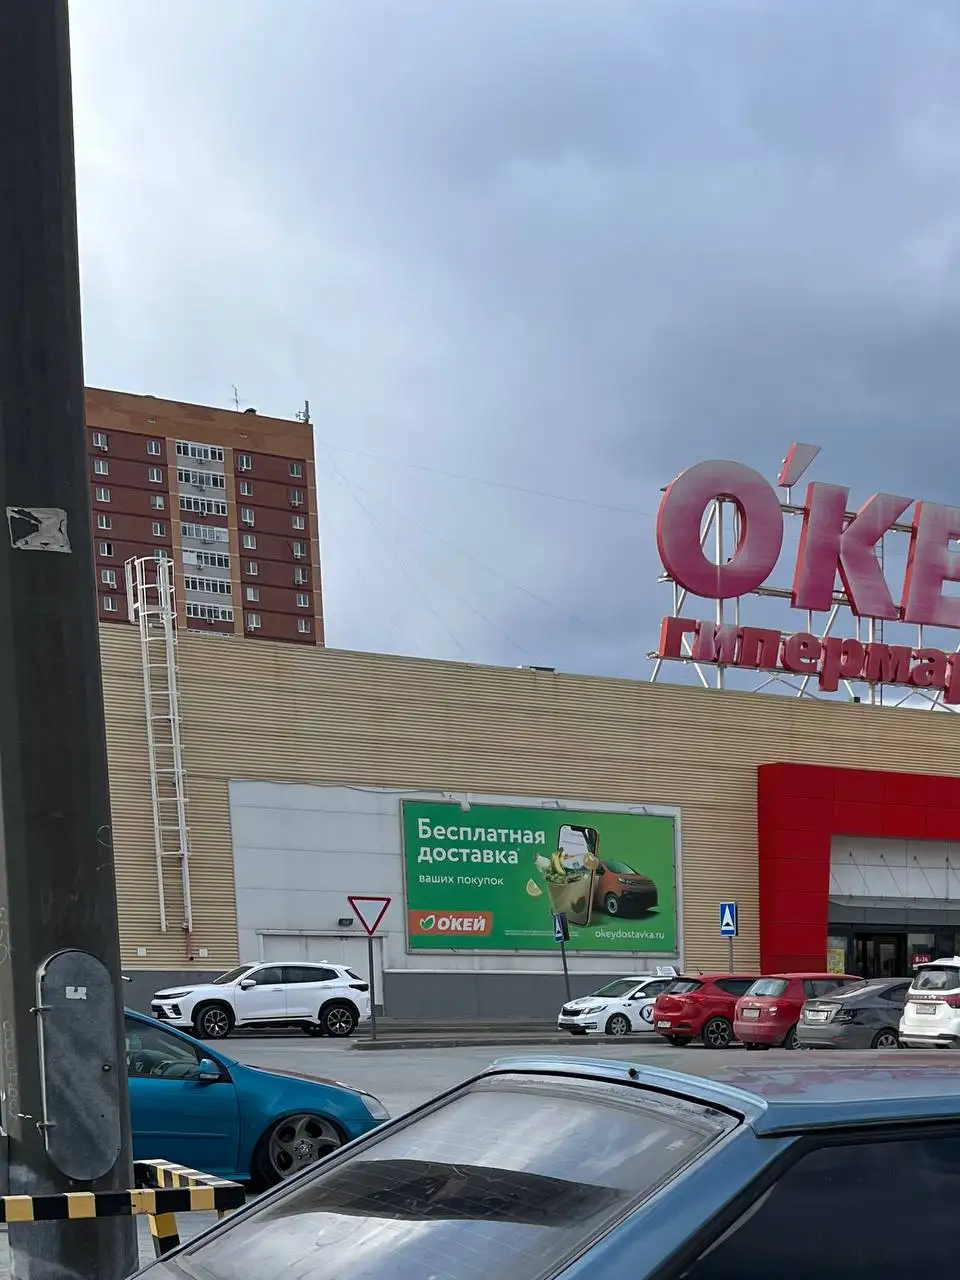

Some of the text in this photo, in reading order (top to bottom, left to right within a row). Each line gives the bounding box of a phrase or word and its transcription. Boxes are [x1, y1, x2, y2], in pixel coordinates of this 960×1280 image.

[417, 817, 546, 845] Бесплатная
[419, 873, 504, 887] ваших покупок
[595, 929, 665, 941] okeydostavka.ru
